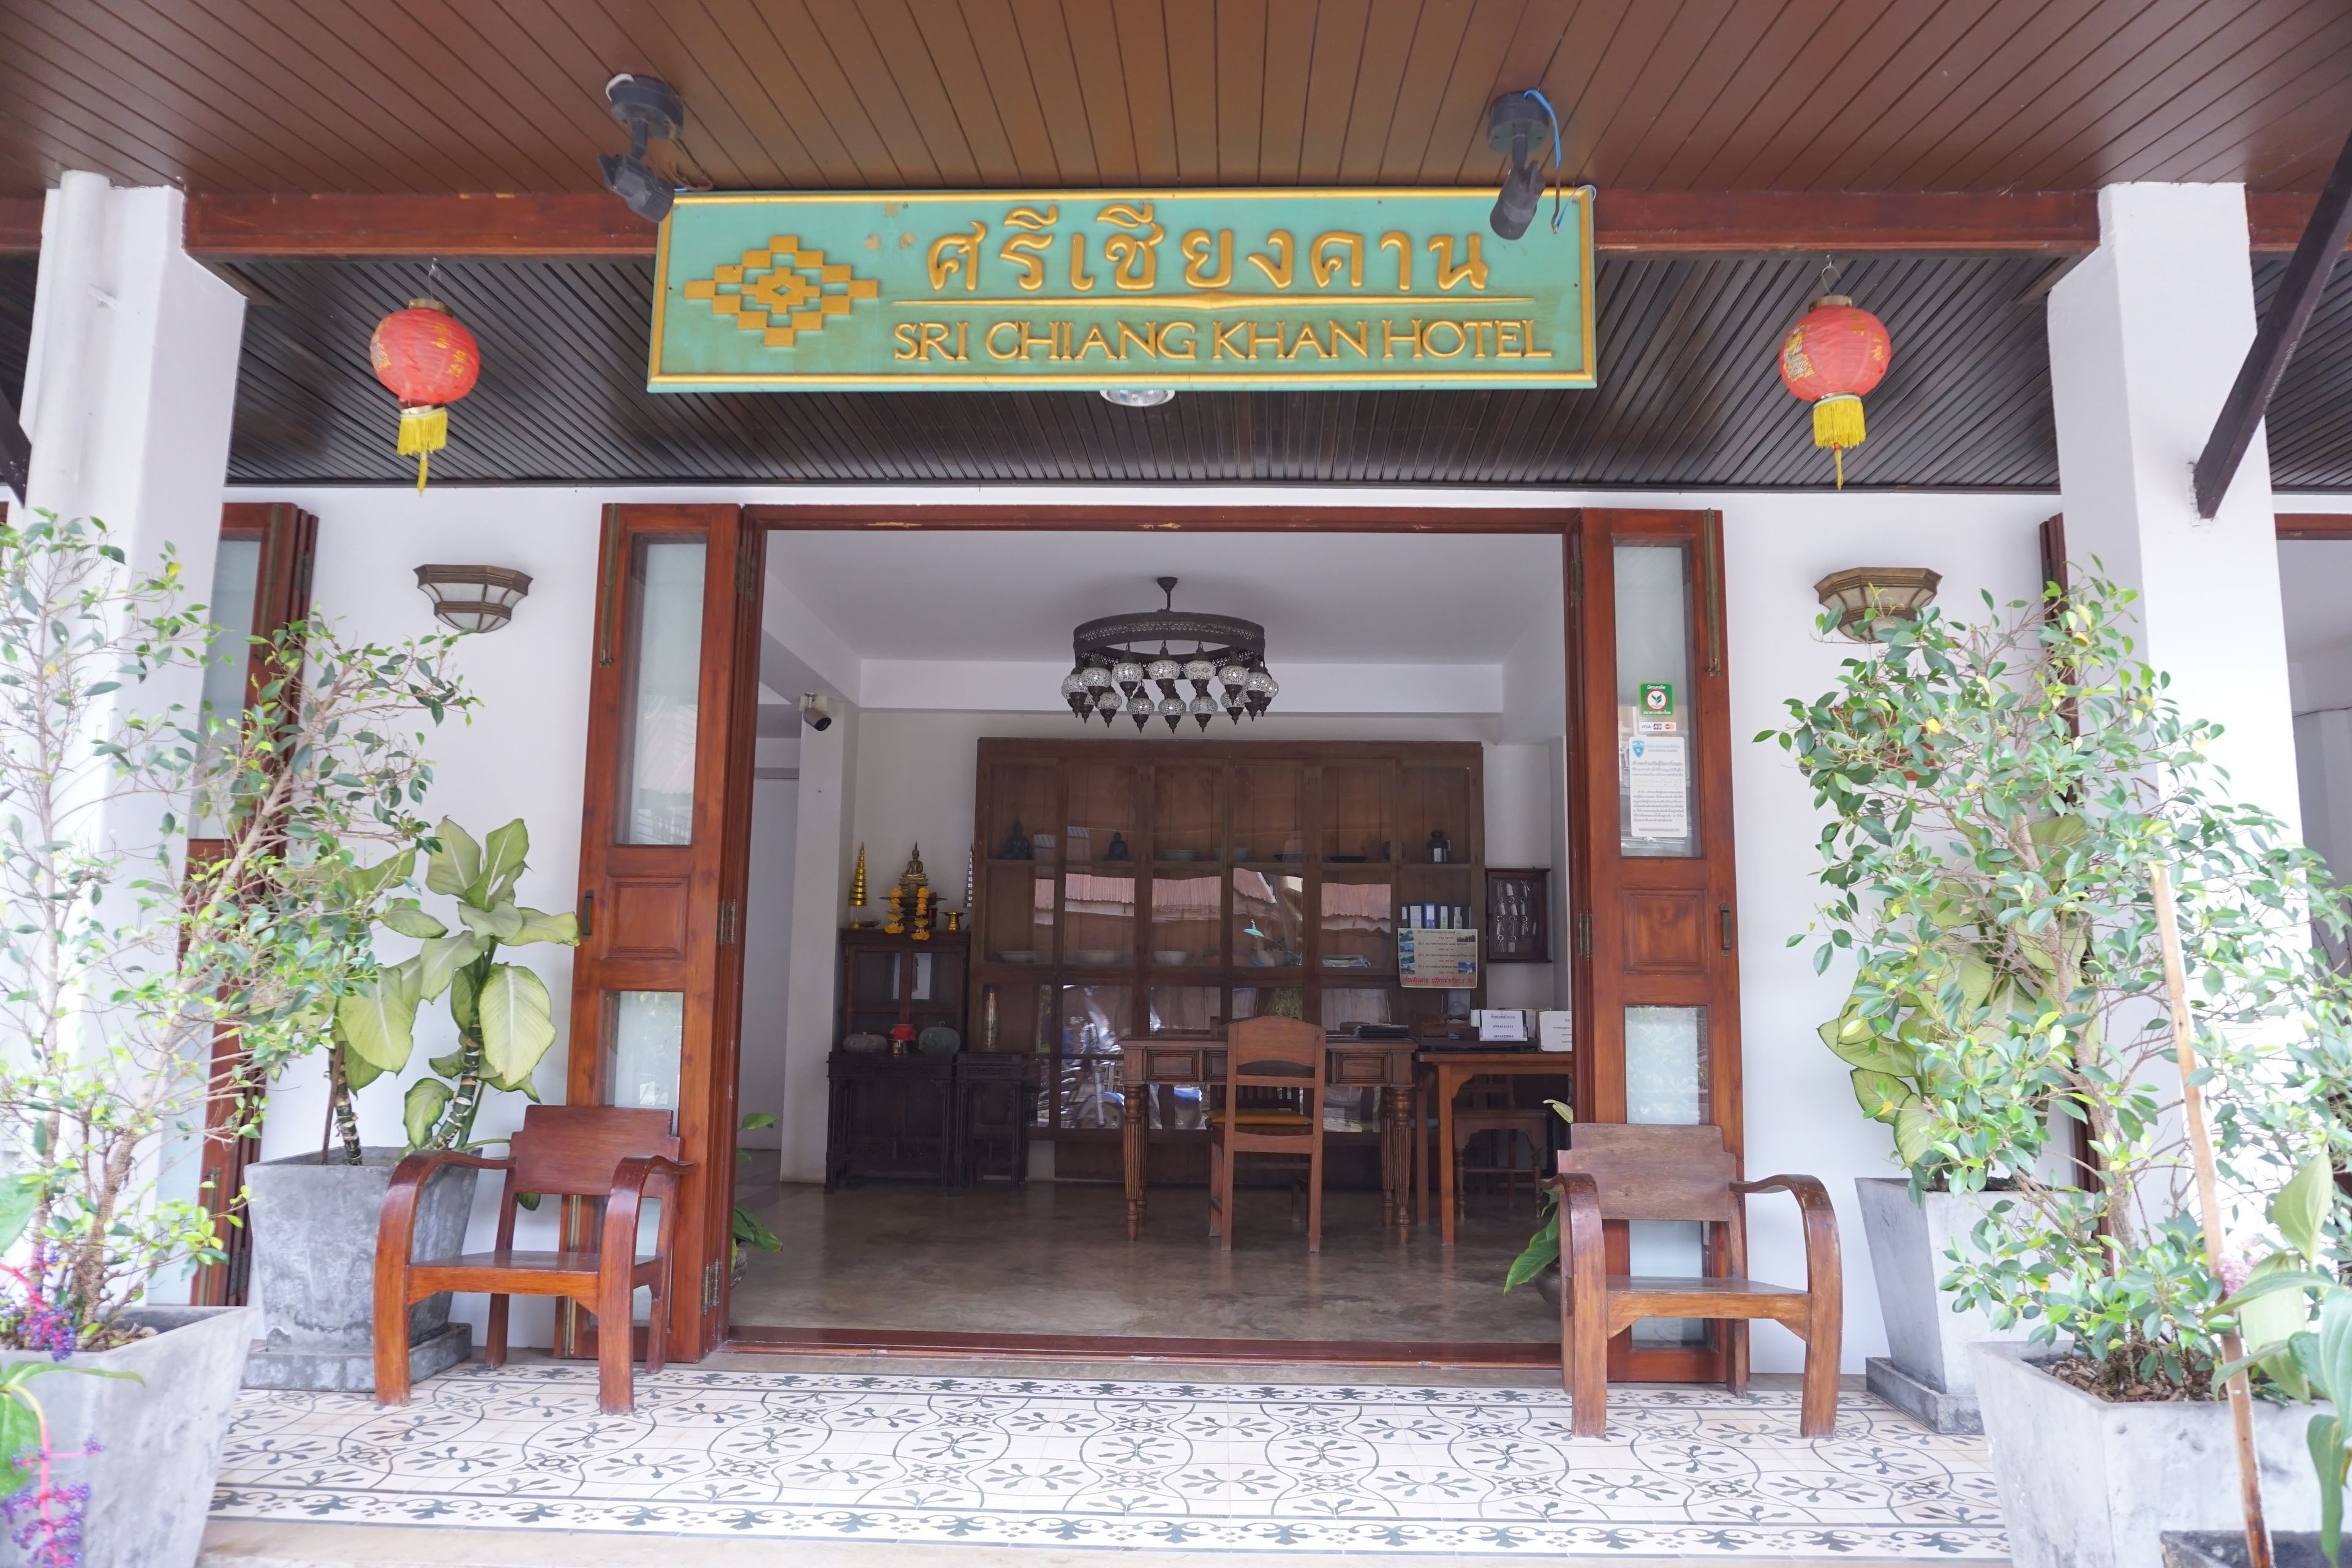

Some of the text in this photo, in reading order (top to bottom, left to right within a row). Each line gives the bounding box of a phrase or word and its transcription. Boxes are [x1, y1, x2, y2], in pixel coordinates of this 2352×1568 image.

[927, 203, 1489, 291] ศรีเชียงคาน
[894, 319, 1552, 361] SRI CHIANG KHAN HOTEL
